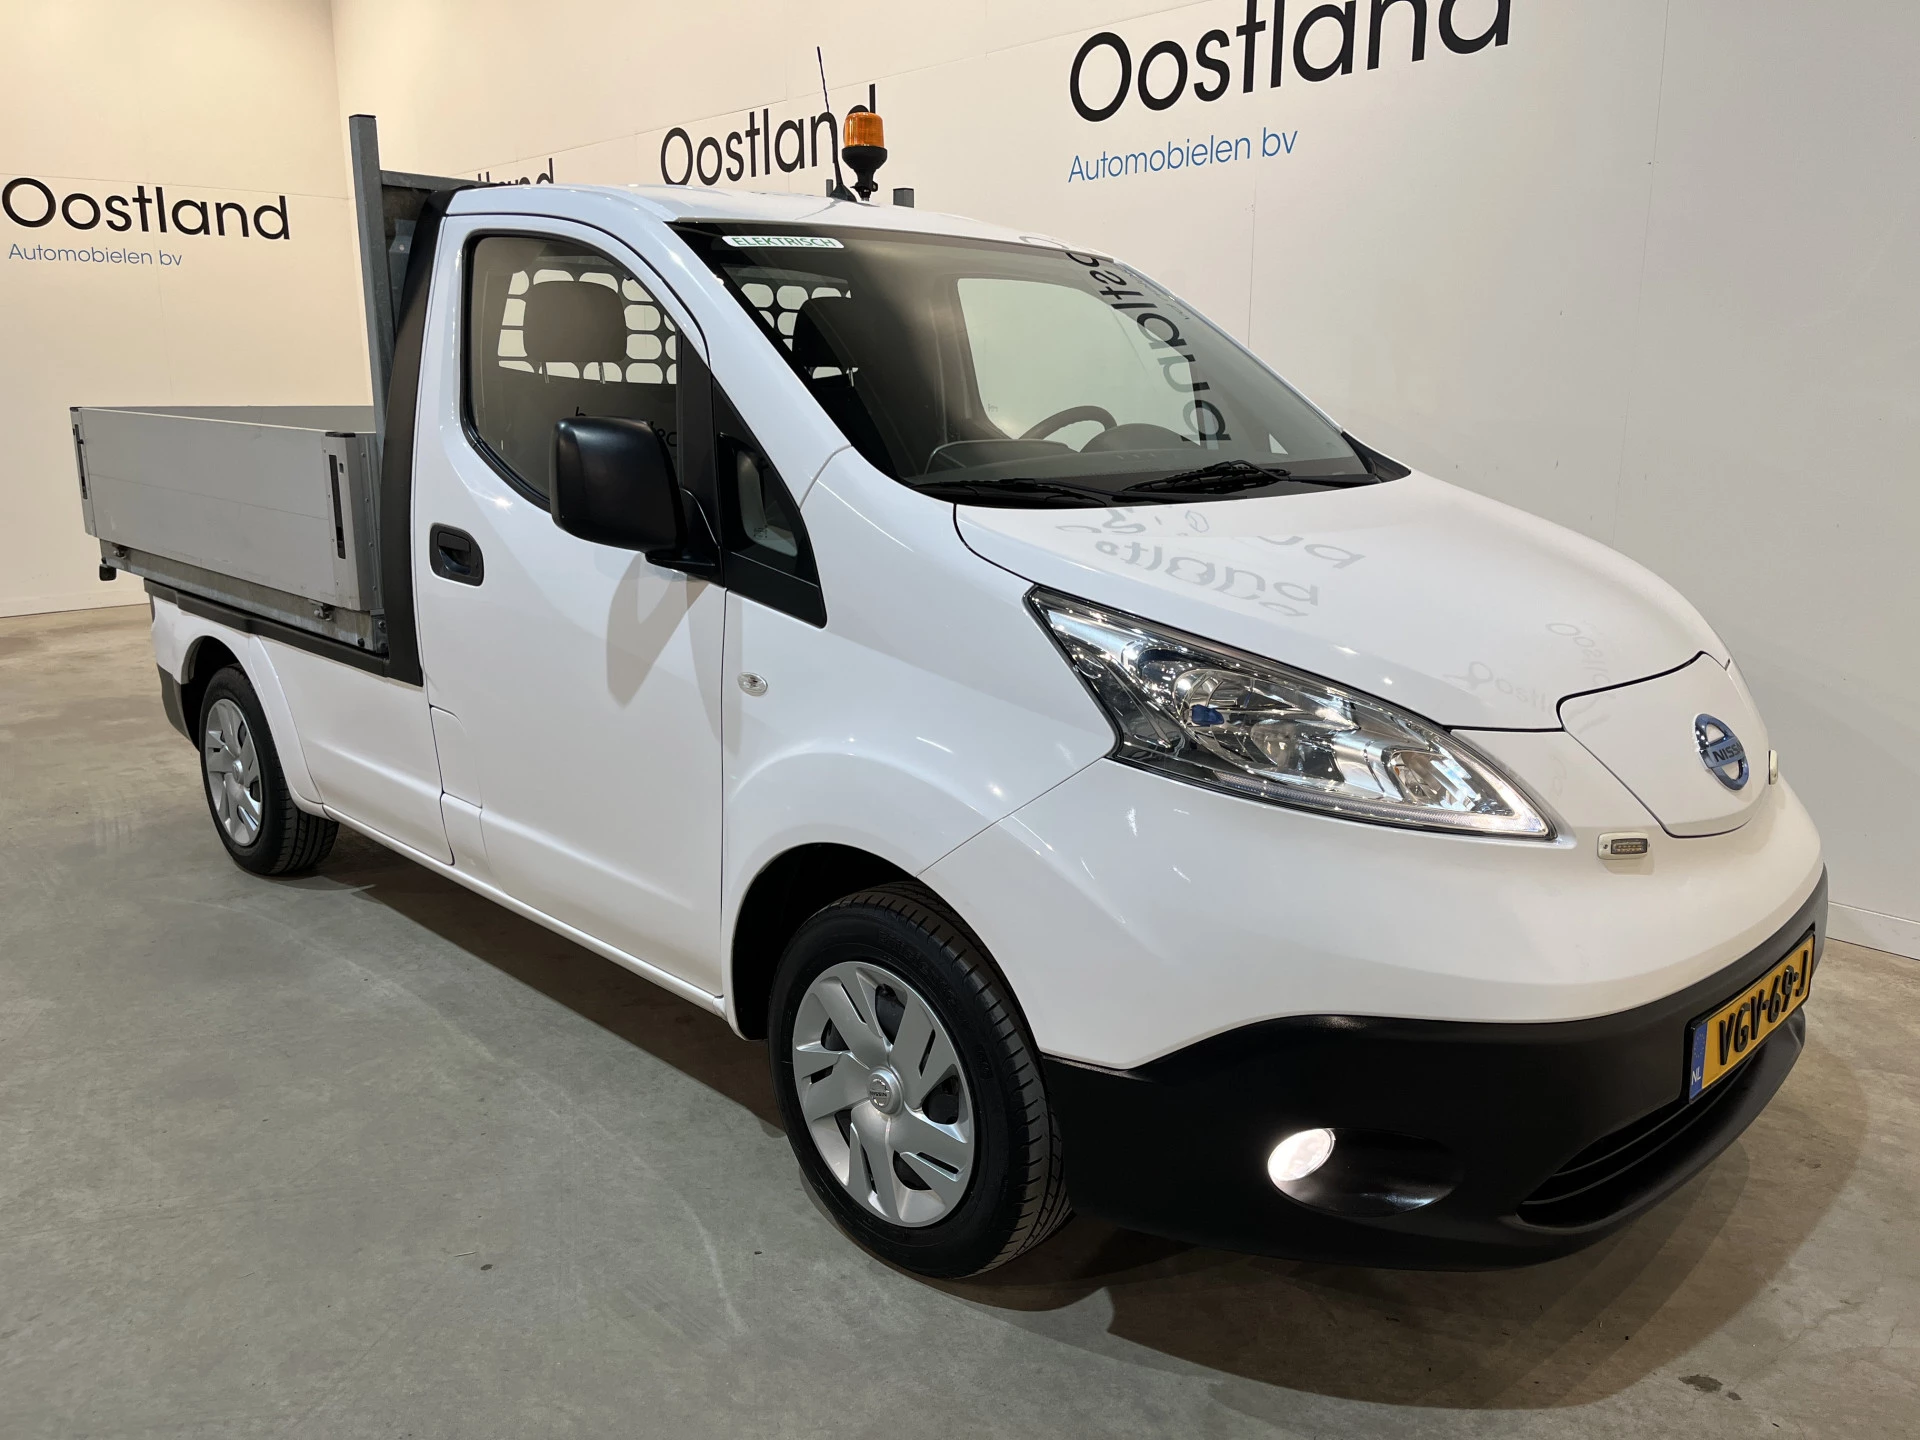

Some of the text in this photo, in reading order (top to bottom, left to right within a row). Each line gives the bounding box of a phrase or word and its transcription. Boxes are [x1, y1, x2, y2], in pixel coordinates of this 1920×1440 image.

[1068, 127, 1298, 183] Automobielen bv
[2, 177, 290, 240] Oostland
[8, 243, 182, 266] Automobielen bv
[731, 237, 836, 247] ELEKTRISCH
[1718, 950, 1809, 1066] VGV-69-J
[1691, 1065, 1702, 1086] NL
